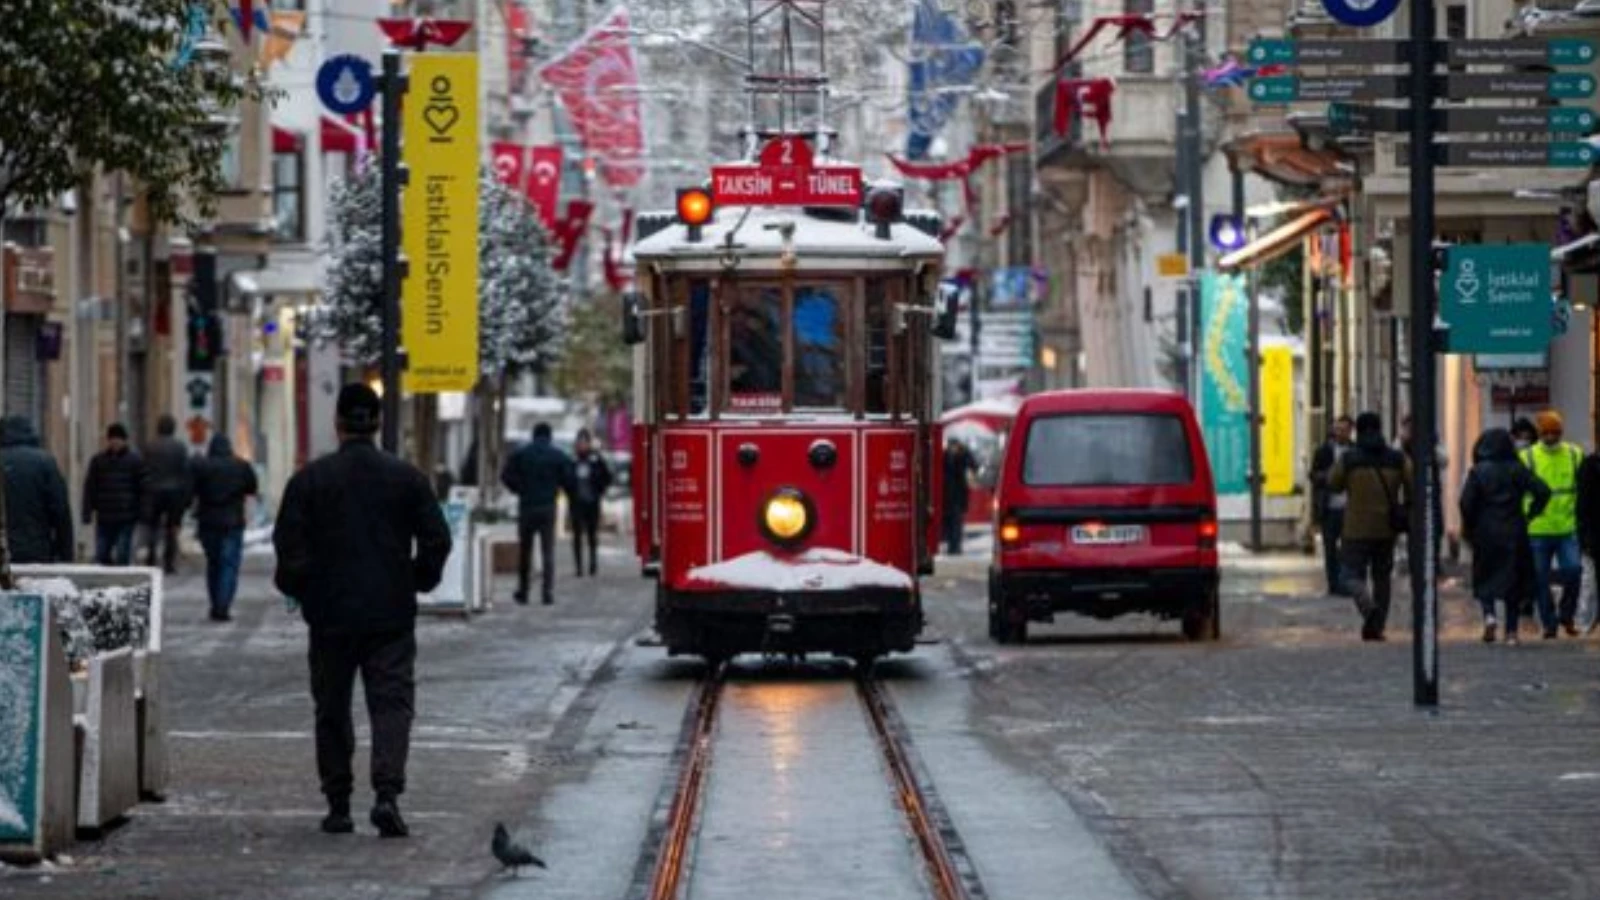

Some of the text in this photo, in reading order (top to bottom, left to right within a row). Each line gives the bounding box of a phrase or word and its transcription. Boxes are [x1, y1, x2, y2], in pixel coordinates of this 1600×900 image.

[780, 140, 793, 164] 2
[717, 171, 772, 195] TAKSİM
[807, 170, 858, 195] TÜNEL
[1488, 267, 1539, 286] İstiklal
[1488, 288, 1533, 303] Senin
